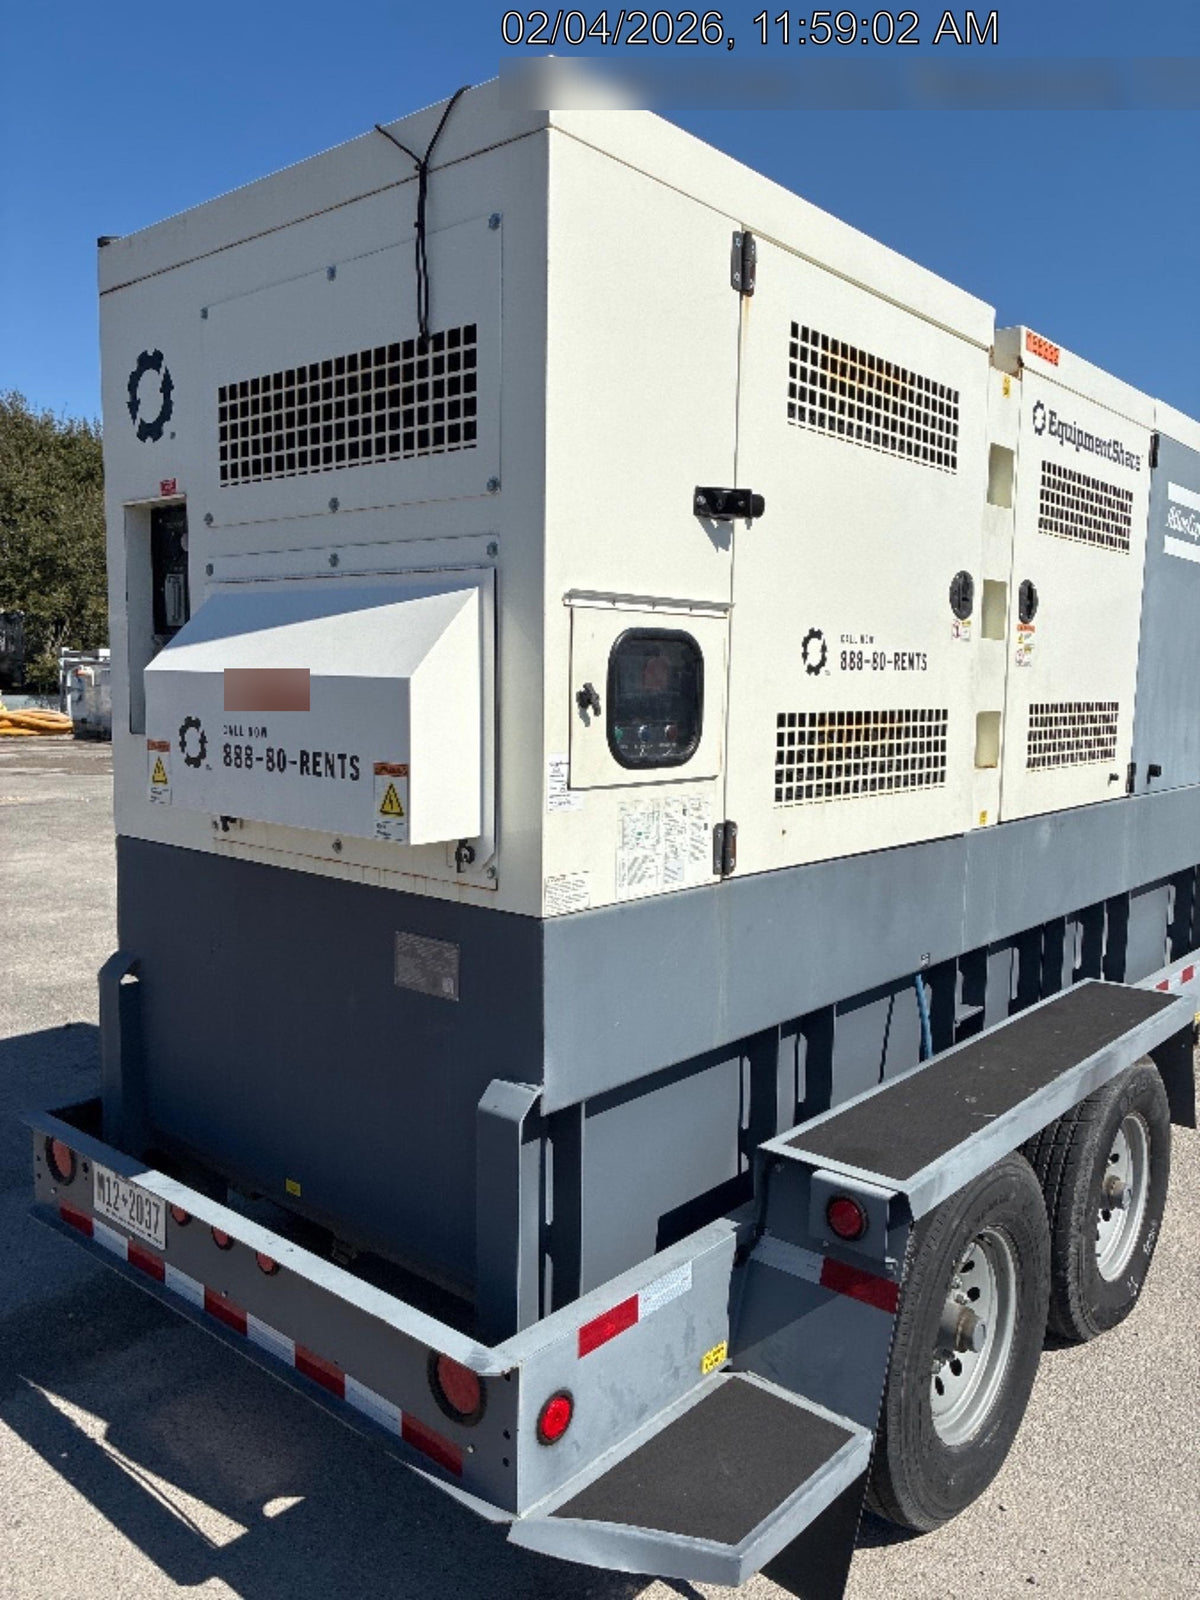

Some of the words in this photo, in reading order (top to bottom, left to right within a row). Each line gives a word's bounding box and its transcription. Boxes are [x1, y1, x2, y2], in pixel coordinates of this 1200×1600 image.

[1048, 409, 1141, 472] EquipmentShare
[840, 650, 927, 671] 888-80-RENTS
[223, 742, 360, 781] 888-80-RENTS
